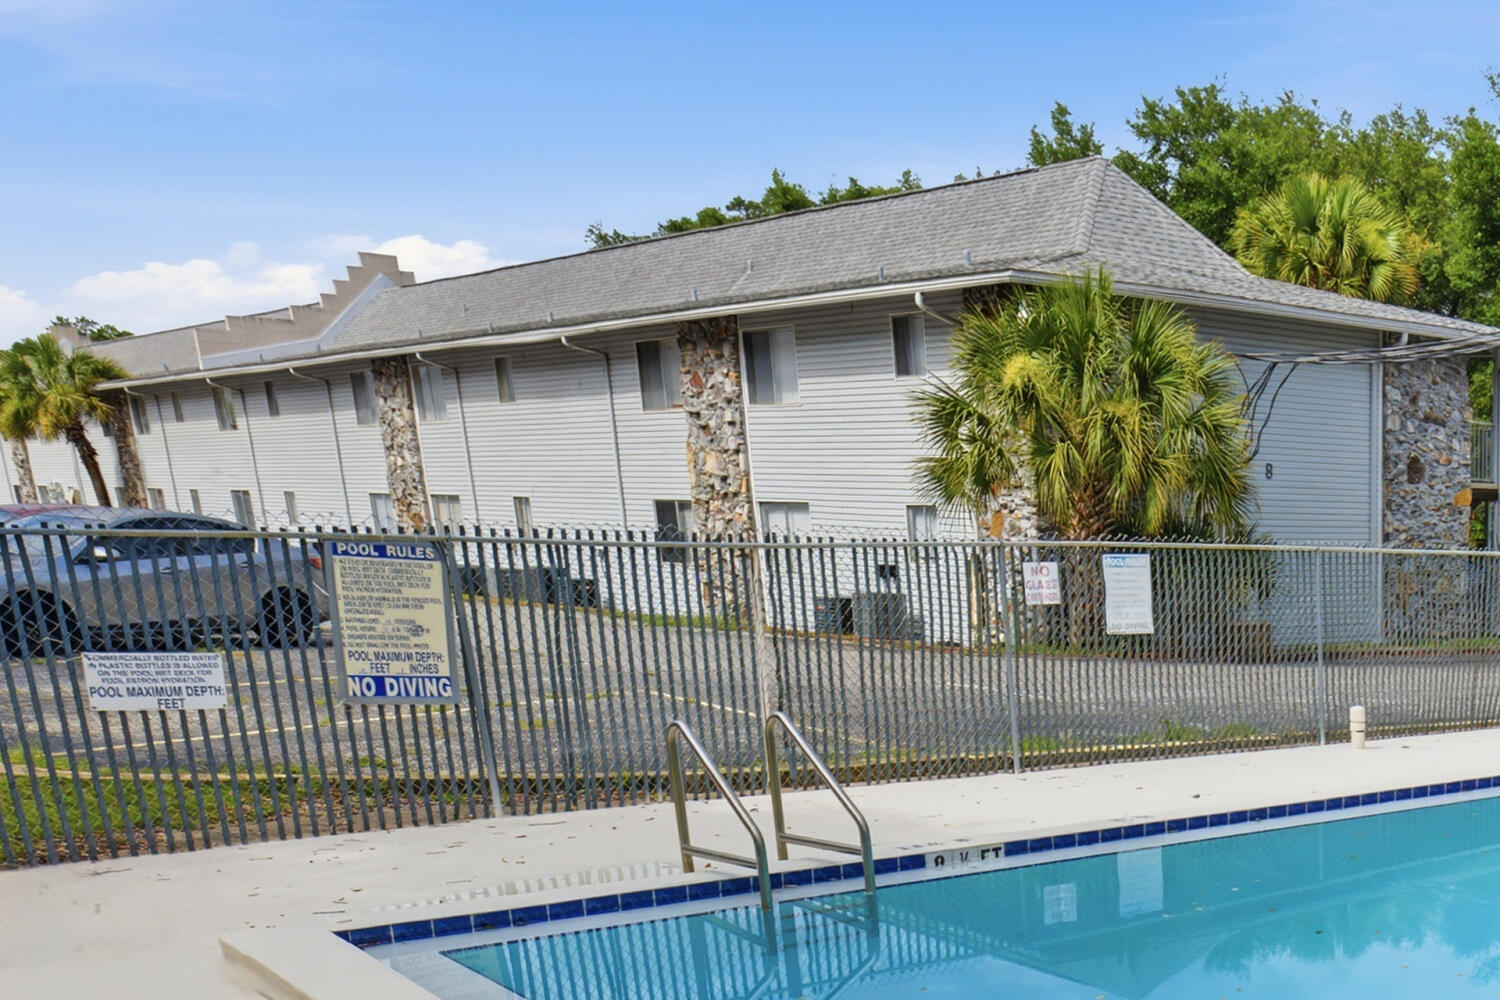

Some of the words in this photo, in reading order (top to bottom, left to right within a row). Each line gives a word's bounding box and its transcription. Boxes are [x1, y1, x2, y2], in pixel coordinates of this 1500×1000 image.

[1265, 463, 1273, 479] 8
[336, 542, 379, 556] POOL
[386, 545, 435, 559] RULES
[1031, 566, 1050, 577] NO
[348, 650, 375, 661] POOL
[374, 651, 414, 662] MAXIMUM
[415, 651, 445, 663] DEPTH:
[370, 663, 390, 673] FEET
[409, 663, 439, 674] INCHES
[90, 686, 123, 698] POOL
[126, 686, 183, 698] MAXIMUM
[185, 685, 225, 697] DEPTH:
[349, 677, 376, 696] NO
[385, 678, 452, 697] DIVING
[157, 698, 186, 709] FEET
